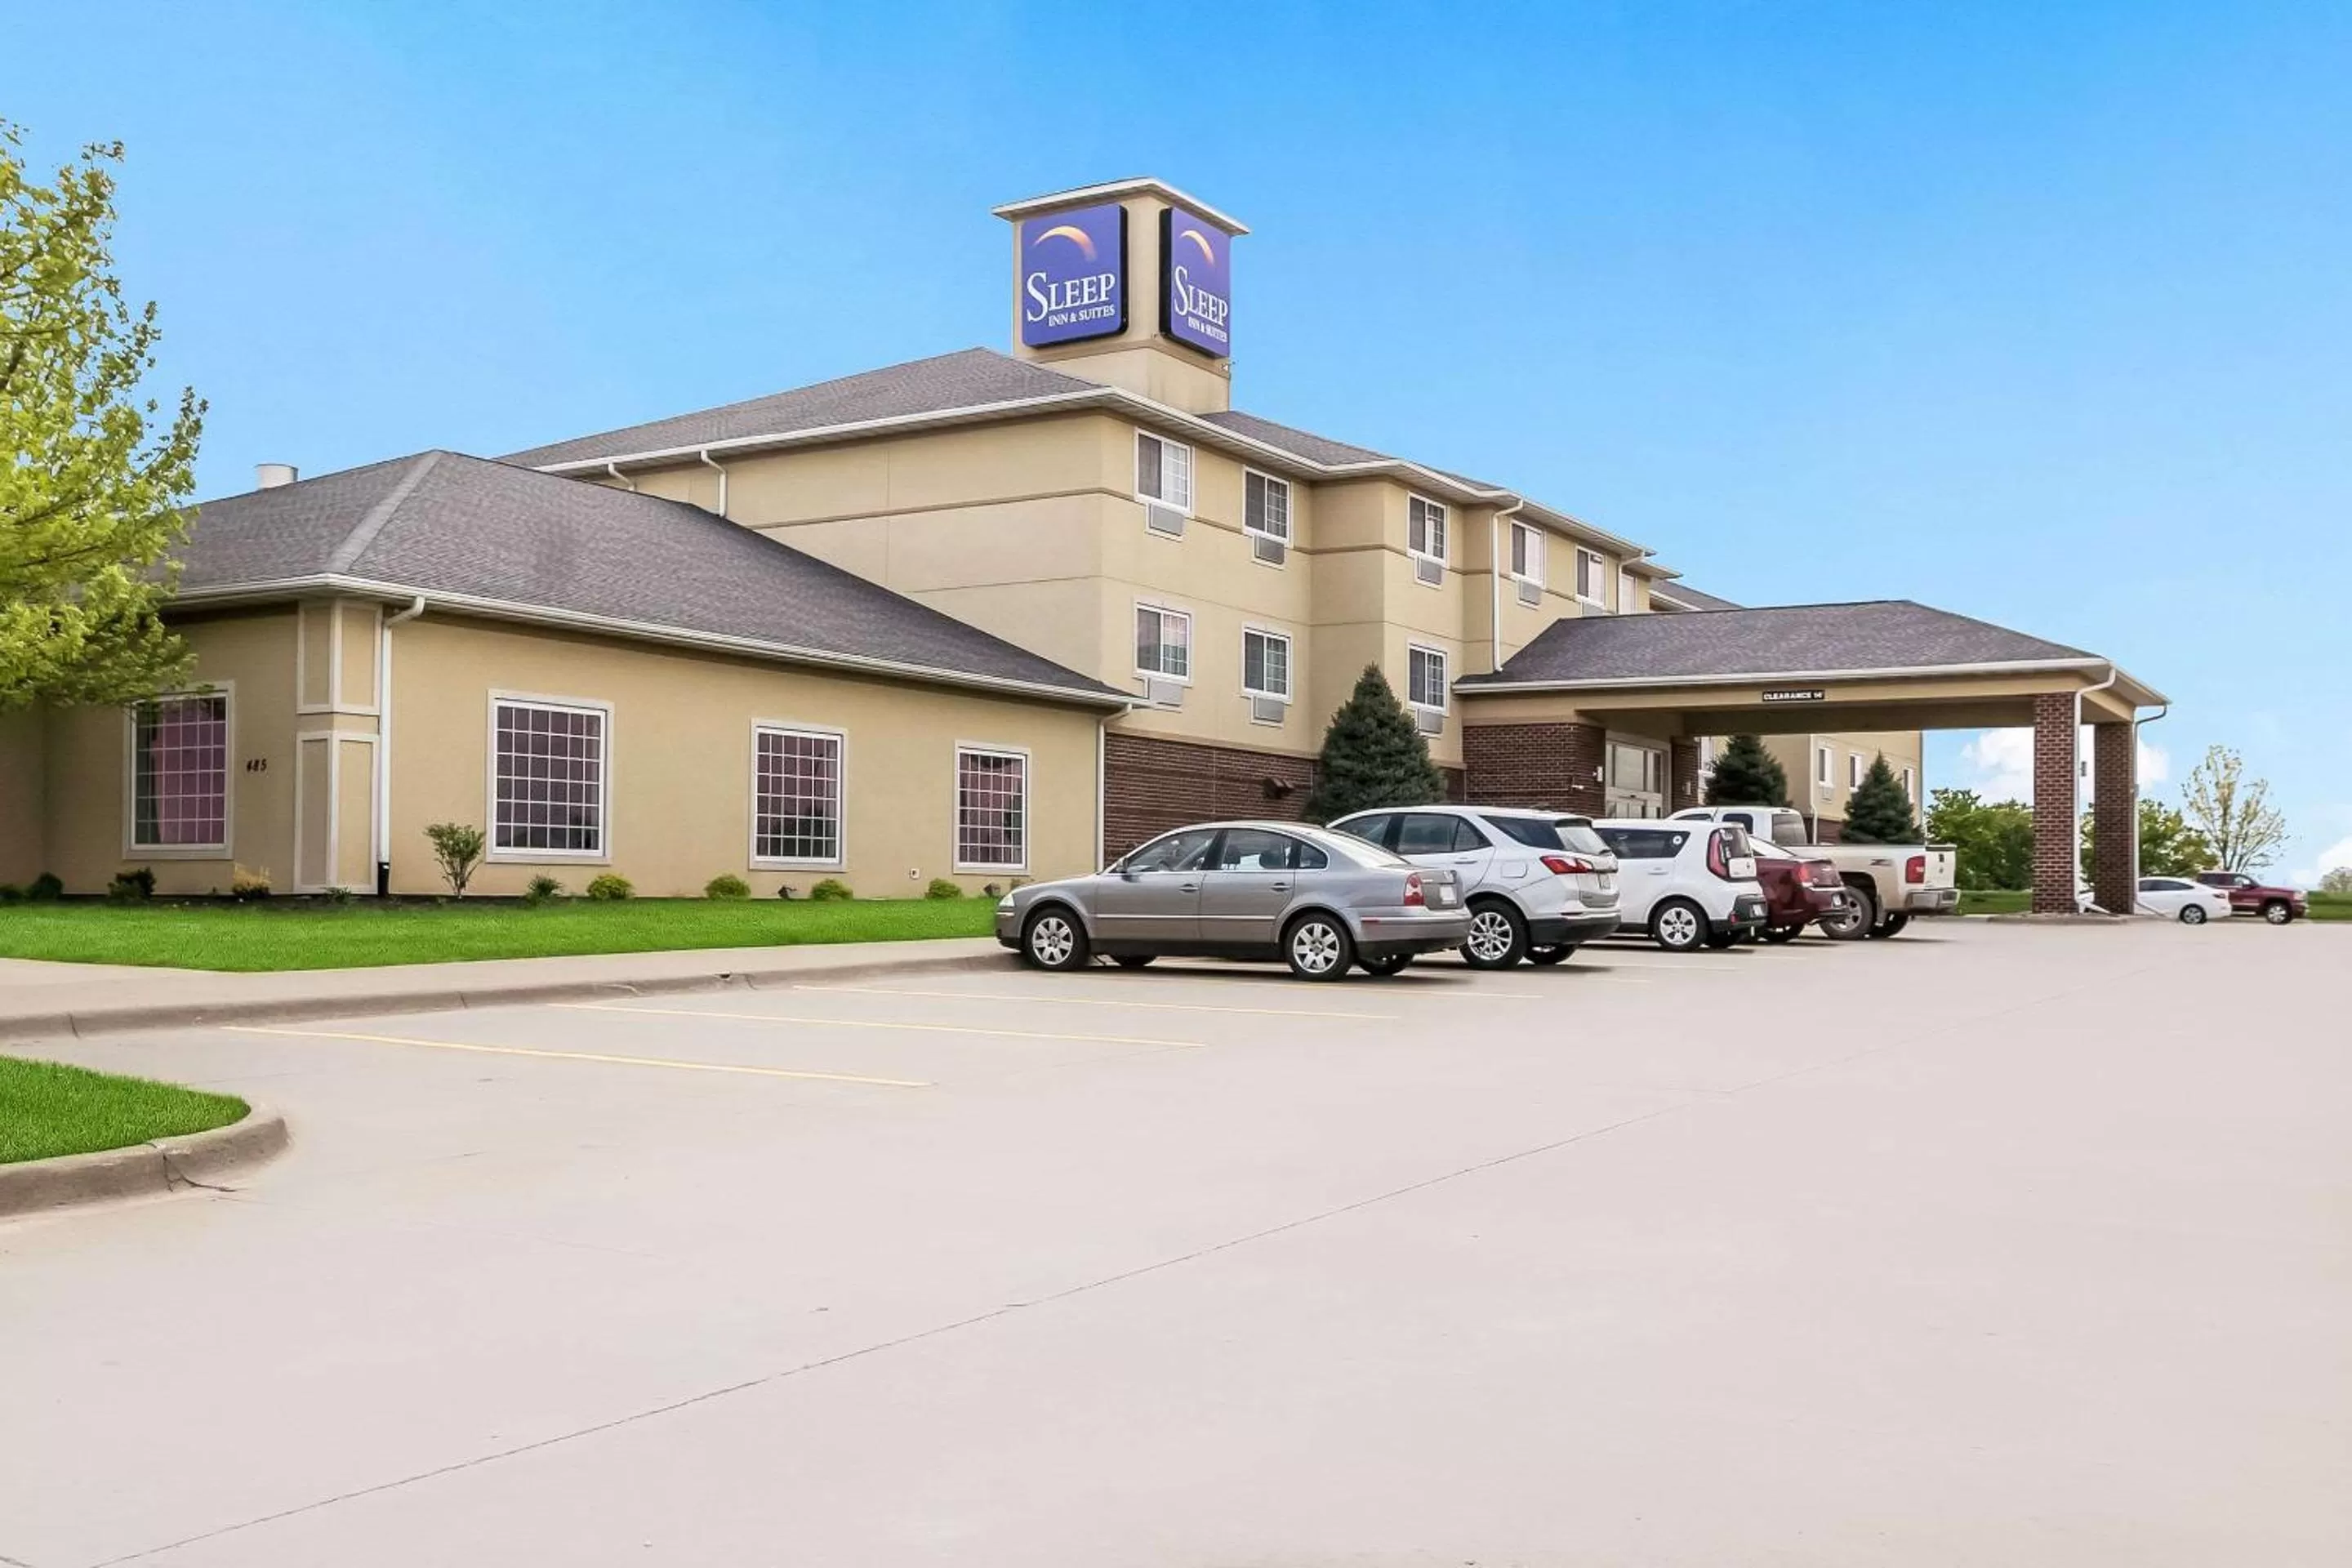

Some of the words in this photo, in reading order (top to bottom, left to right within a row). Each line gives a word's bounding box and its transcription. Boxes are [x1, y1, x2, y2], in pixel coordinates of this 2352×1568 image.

[1027, 272, 1116, 322] SLEEP
[1049, 313, 1068, 327] INN
[1069, 312, 1077, 323] &
[1078, 304, 1116, 321] SUITES
[1174, 265, 1228, 326] SLEEP
